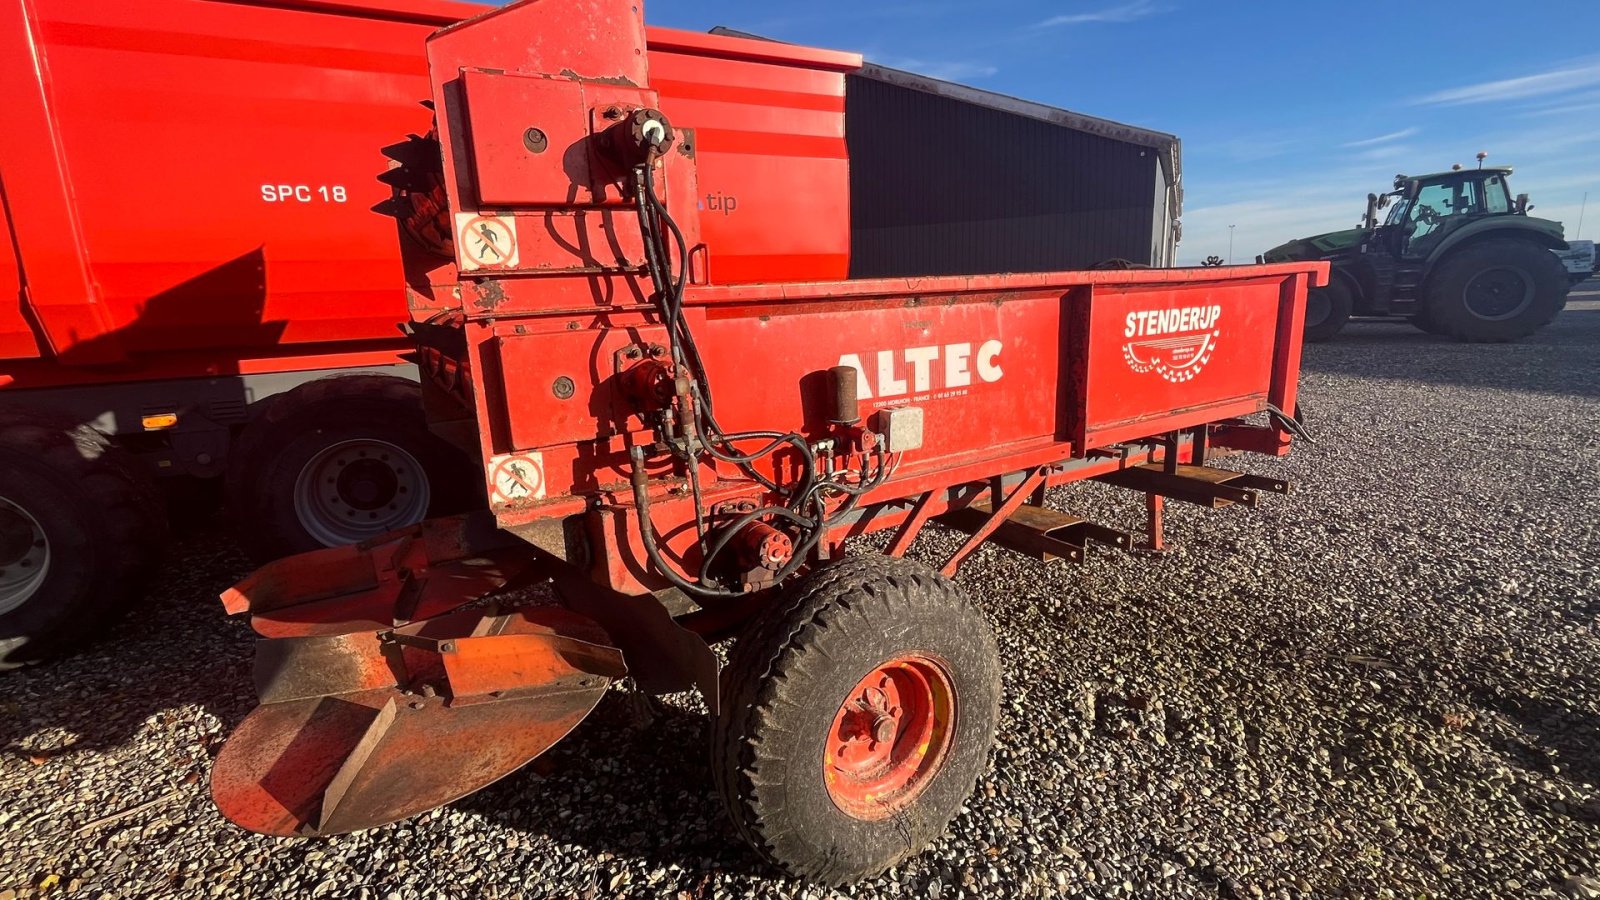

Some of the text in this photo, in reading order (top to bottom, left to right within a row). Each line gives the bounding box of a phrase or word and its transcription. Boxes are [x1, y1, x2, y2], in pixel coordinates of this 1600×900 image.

[261, 184, 347, 202] SPC 18
[706, 191, 737, 216] tip
[1124, 305, 1221, 338] STENDERUP
[838, 339, 1004, 400] ALTEC
[913, 394, 930, 403] FRANCE
